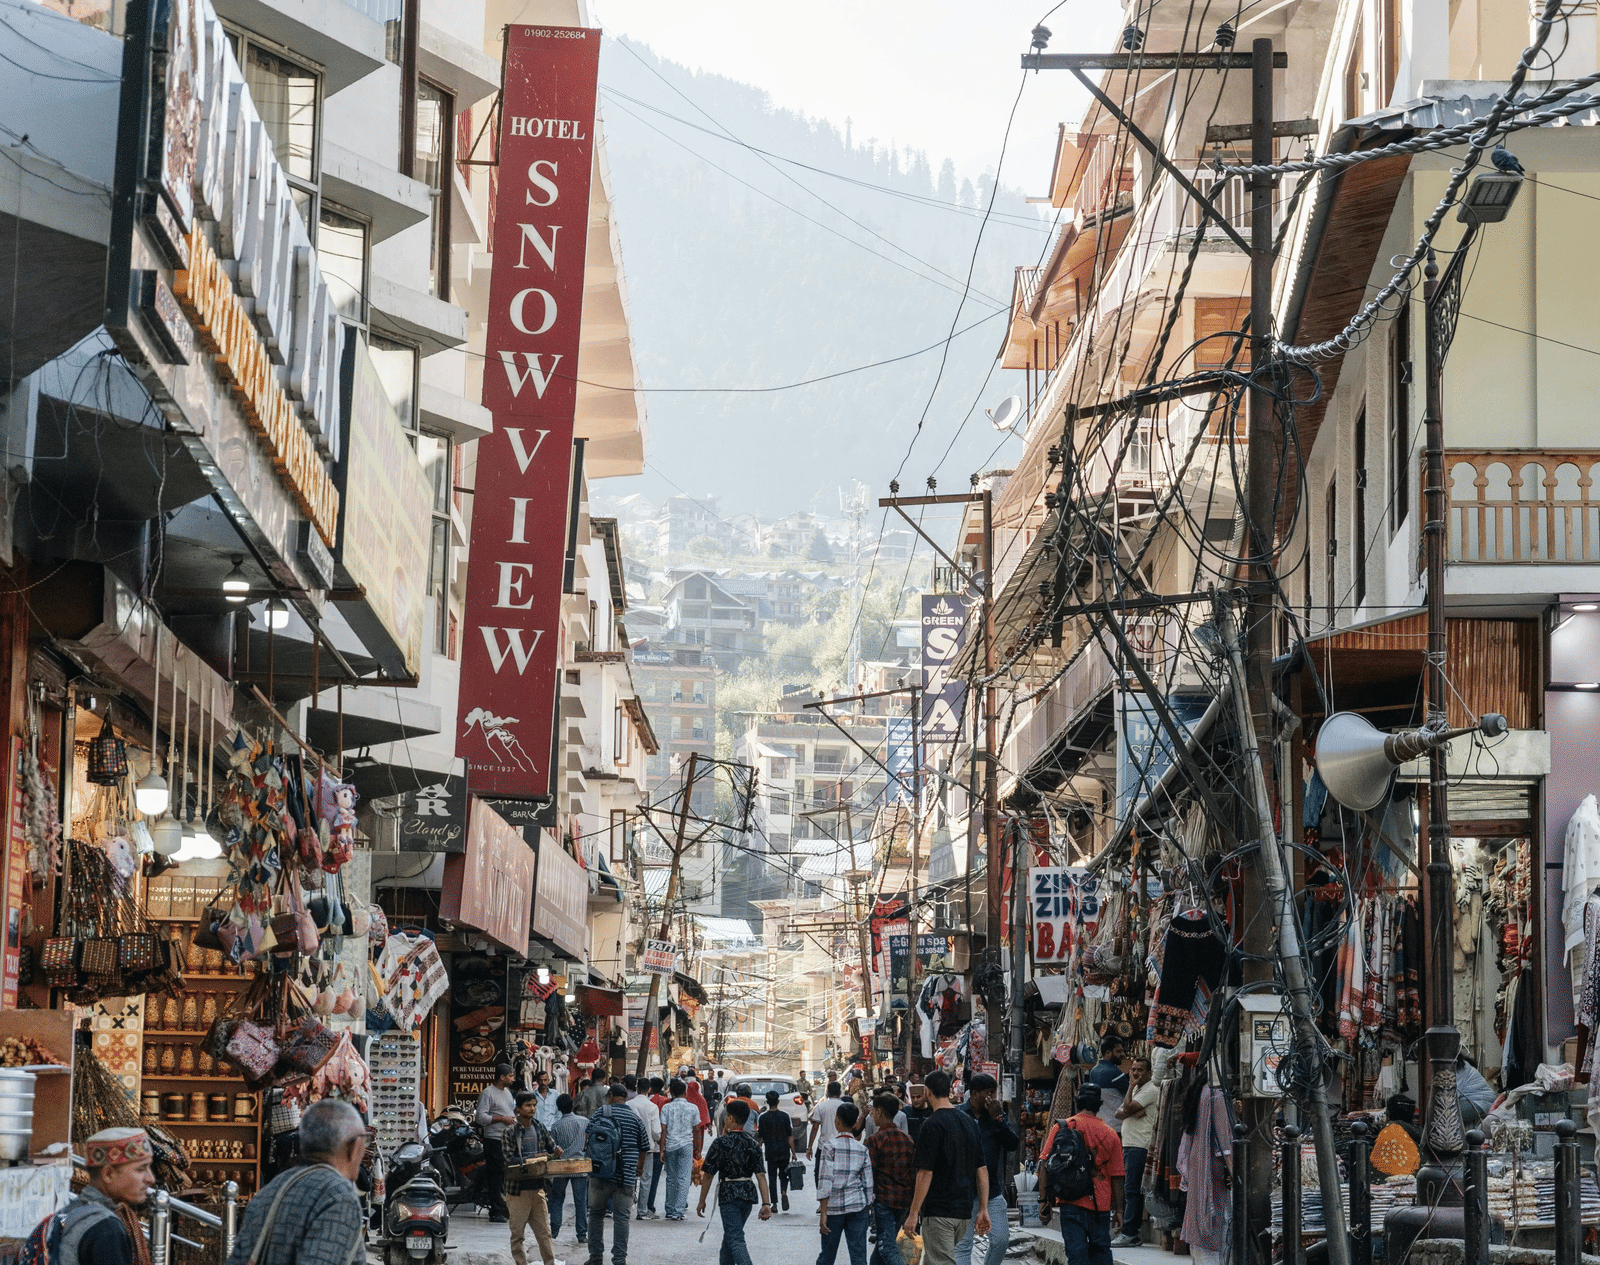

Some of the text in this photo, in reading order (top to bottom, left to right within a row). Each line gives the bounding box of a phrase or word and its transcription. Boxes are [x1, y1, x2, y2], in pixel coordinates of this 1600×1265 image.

[524, 28, 587, 40] 01902-252684
[509, 116, 586, 140] HOTEL
[478, 159, 563, 675] SNOW VIEW
[922, 616, 964, 626] GREEN
[468, 764, 517, 773] SINCE 1937
[404, 818, 450, 836] Cloud
[646, 950, 674, 961] FOOD
